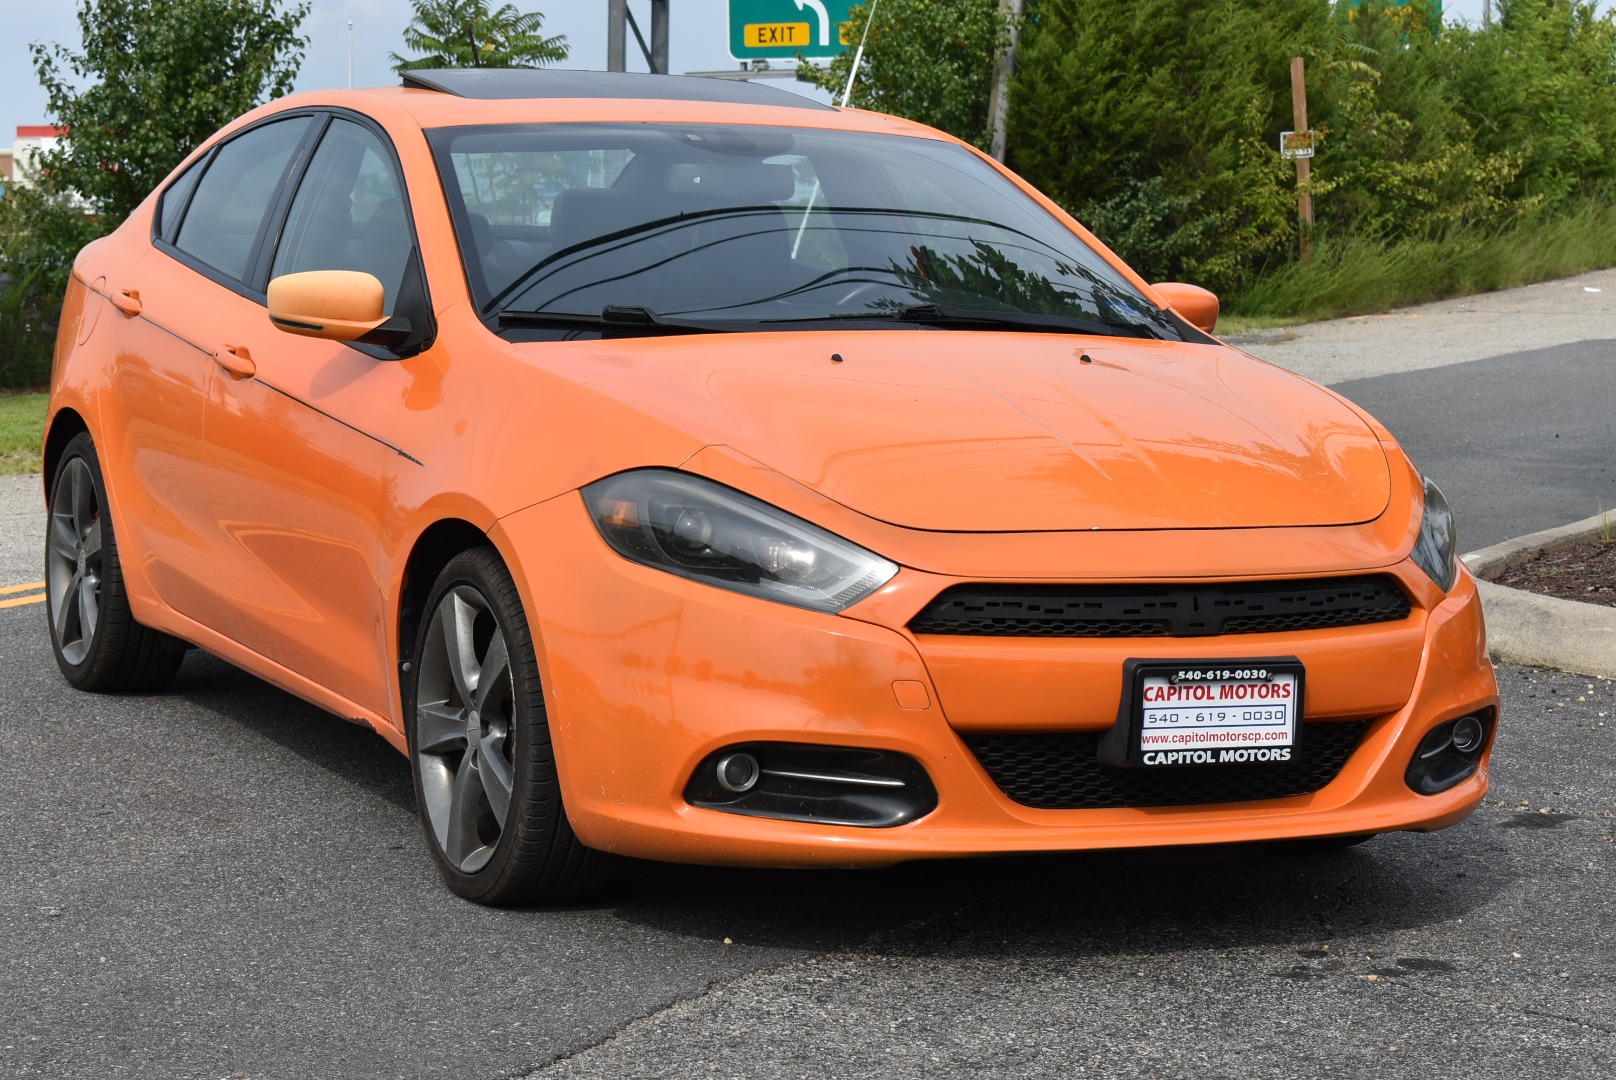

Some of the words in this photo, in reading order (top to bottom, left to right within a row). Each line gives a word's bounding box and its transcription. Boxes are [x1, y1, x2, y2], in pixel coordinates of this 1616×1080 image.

[758, 27, 795, 43] EXIT
[1178, 669, 1267, 680] 540-619-0030
[1143, 685, 1215, 702] CAPITOL
[1219, 683, 1291, 700] MOTORS
[1142, 730, 1288, 745] www.capitolmotorscp.com
[1143, 751, 1215, 765] CAPITOL
[1219, 748, 1291, 762] MOTORS
